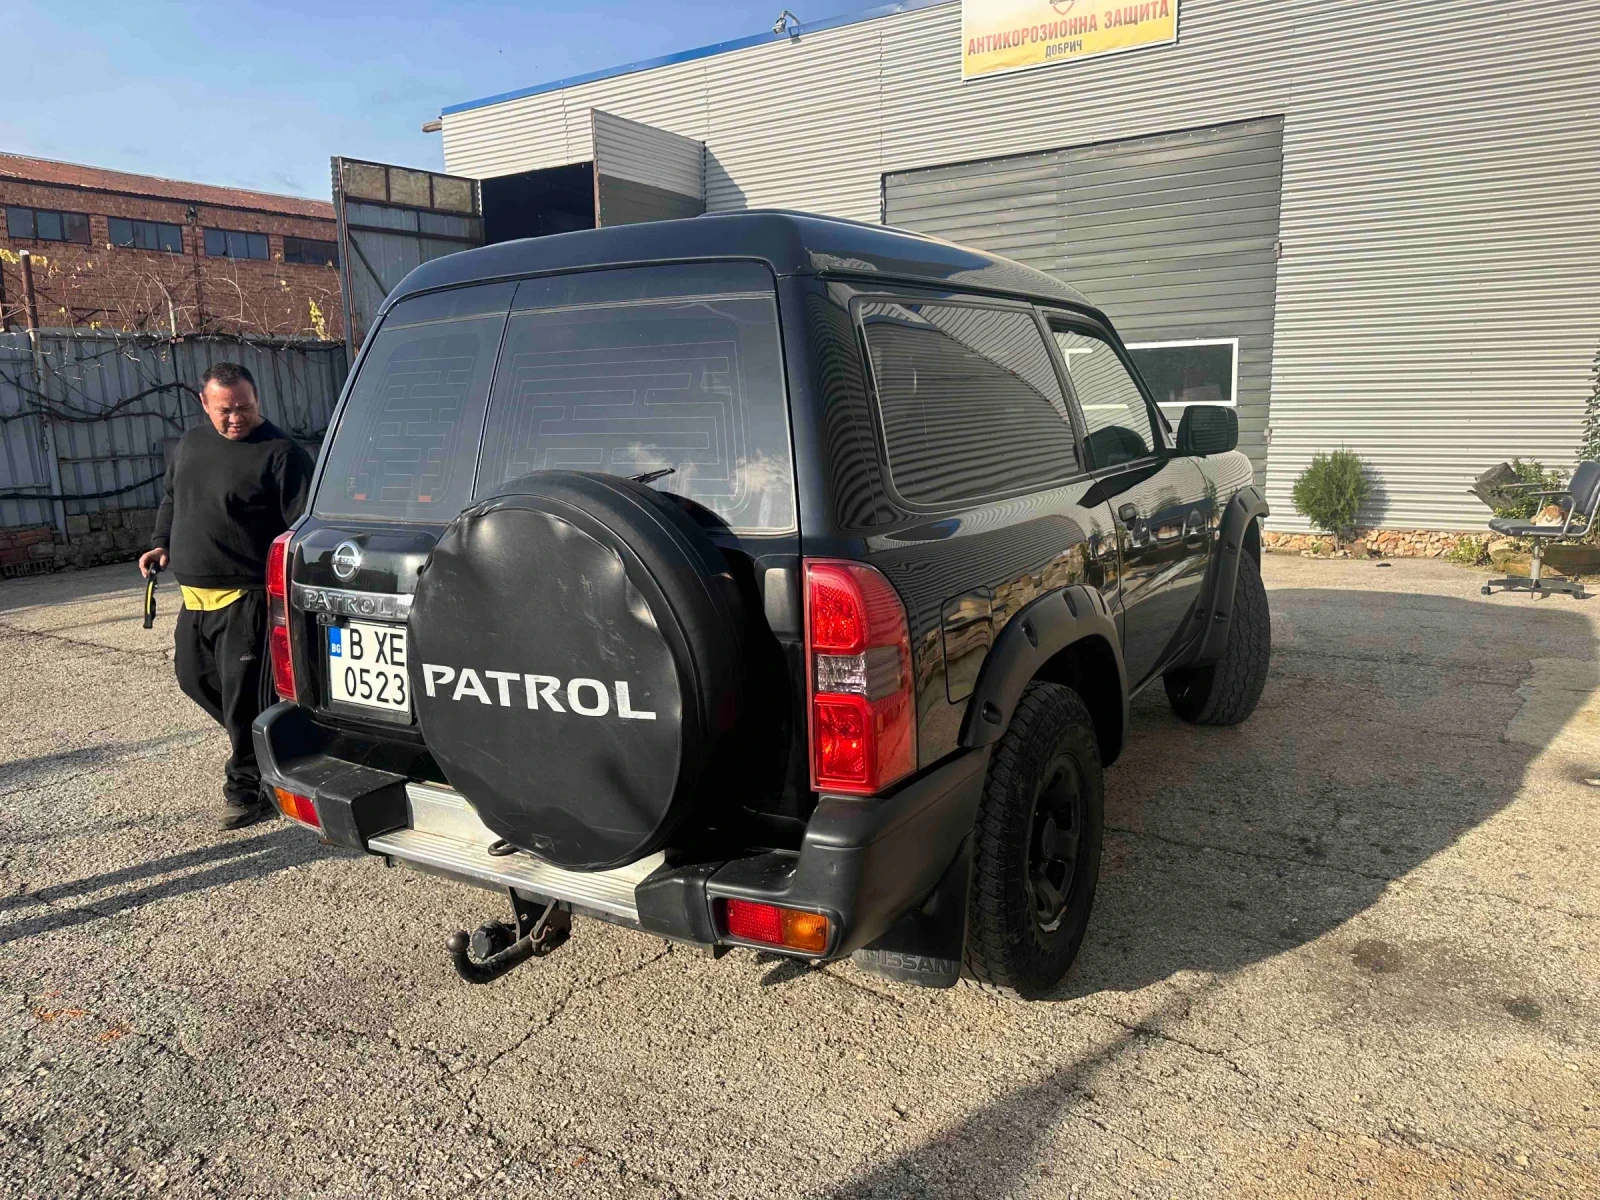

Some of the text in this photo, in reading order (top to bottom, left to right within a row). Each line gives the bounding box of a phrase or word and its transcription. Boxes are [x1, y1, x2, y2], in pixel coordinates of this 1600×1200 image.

[968, 0, 1169, 56] АНТИКОРОЗИОННА ЗАЩИТА
[1045, 39, 1083, 58] ДОБРИЧ
[303, 589, 394, 617] PATROL
[331, 643, 341, 654] BG
[350, 628, 405, 667] B XE
[344, 666, 406, 705] 0523
[422, 663, 657, 720] PATROL
[863, 949, 953, 974] NISSAN
